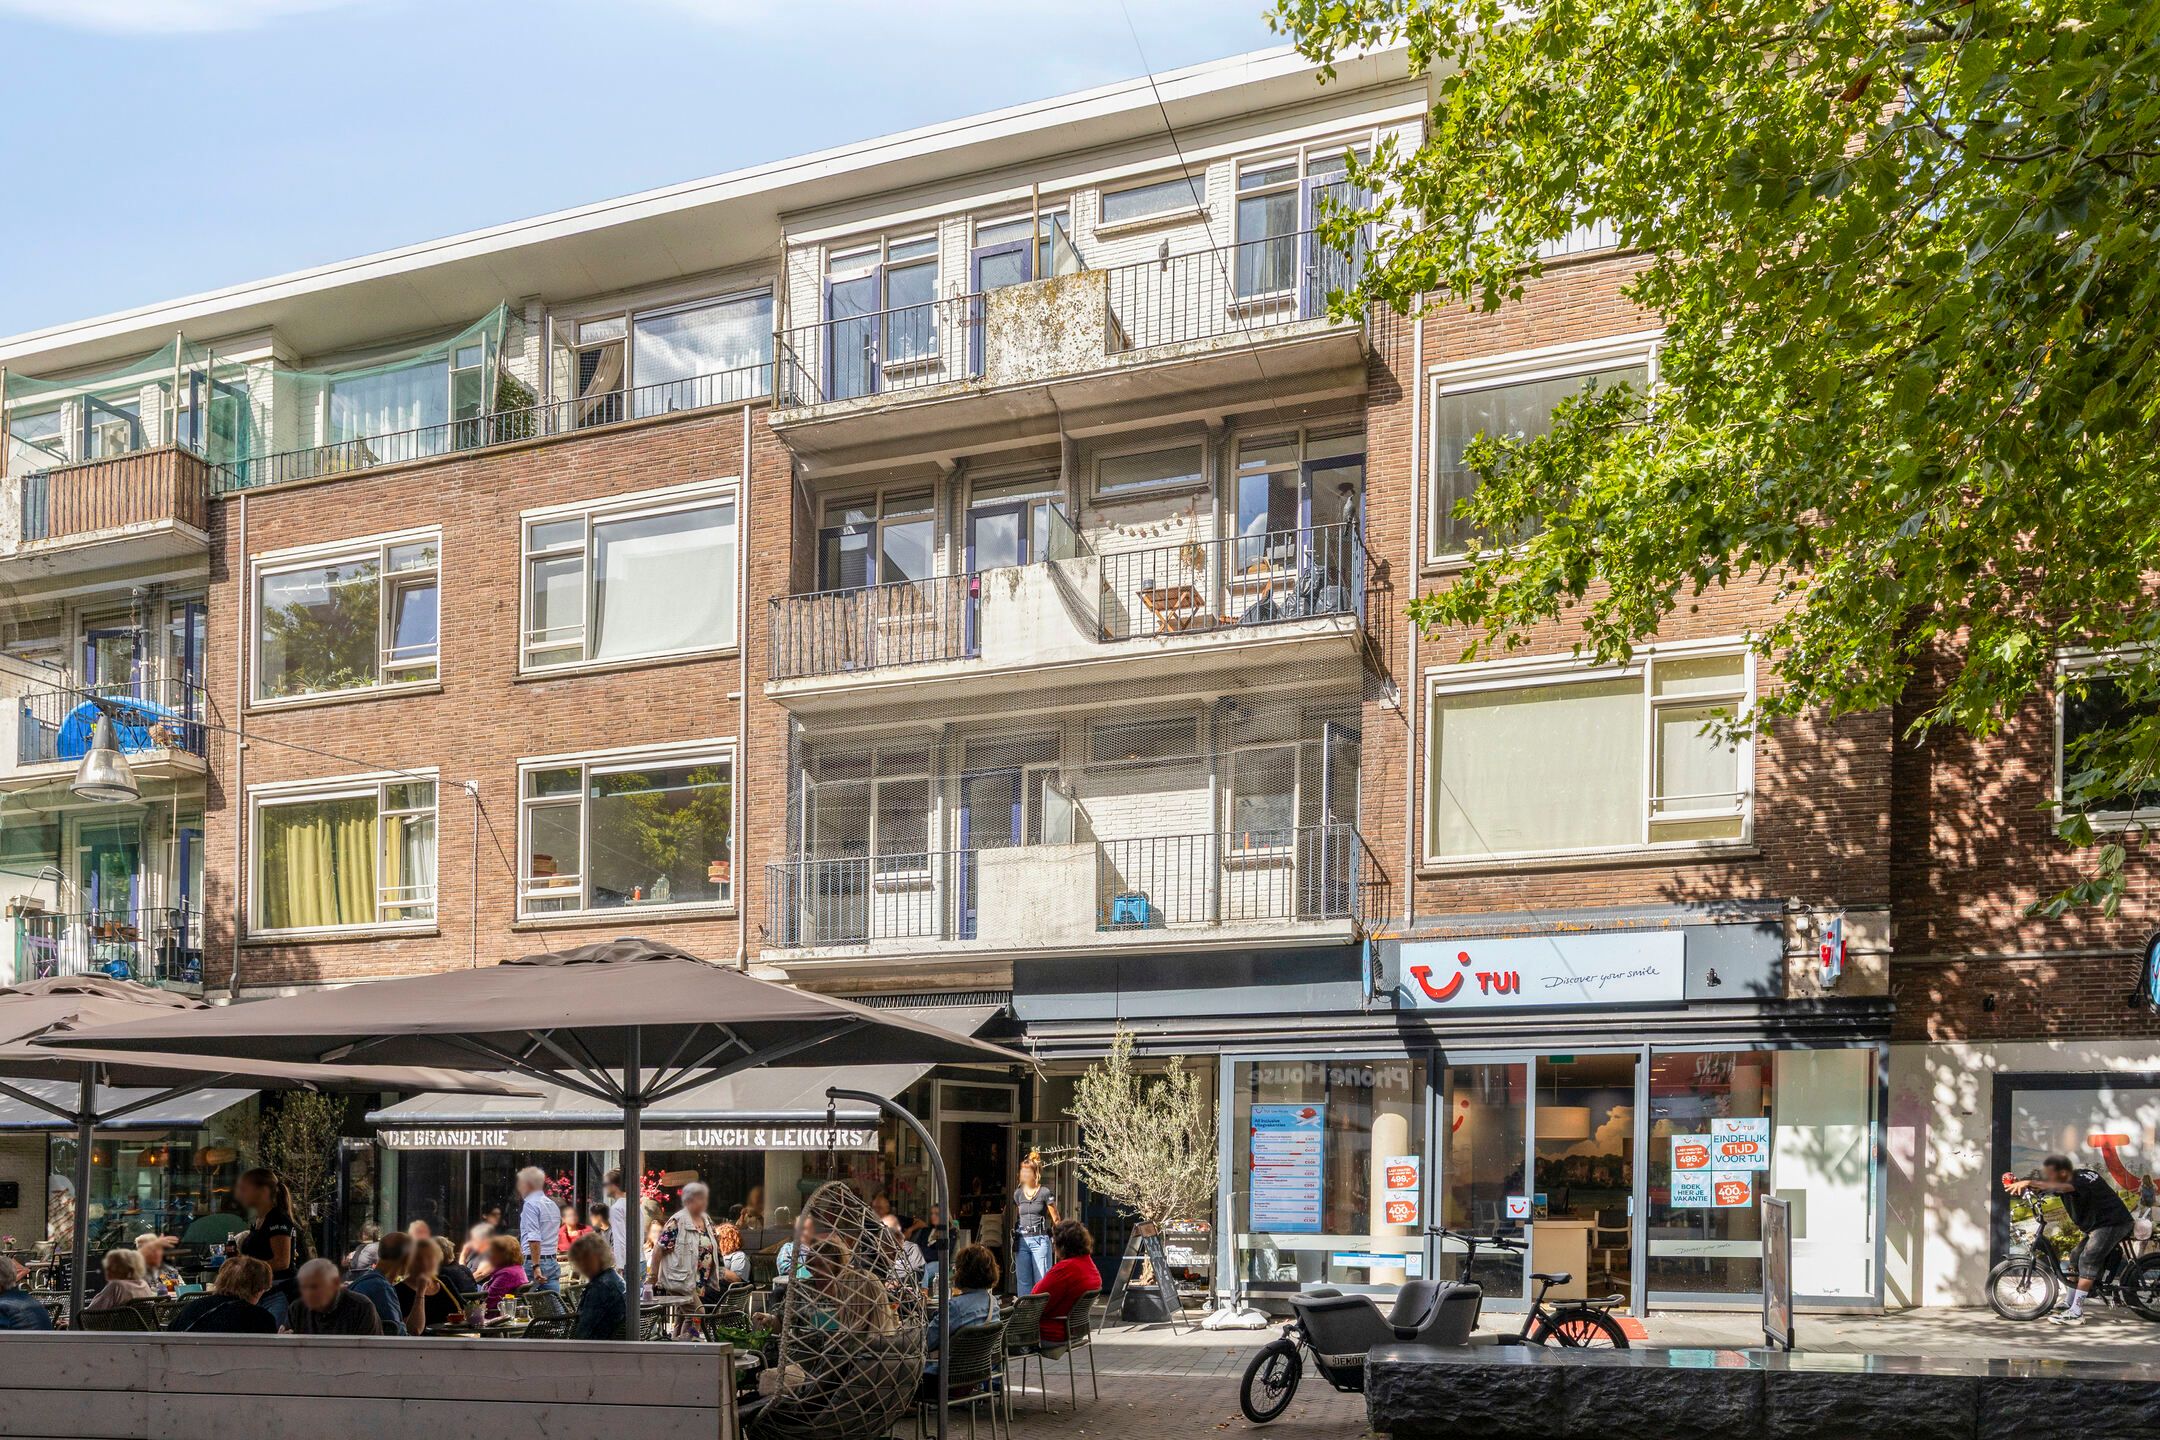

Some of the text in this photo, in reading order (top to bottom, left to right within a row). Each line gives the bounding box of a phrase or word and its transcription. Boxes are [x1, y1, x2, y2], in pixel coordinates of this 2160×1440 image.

[1475, 971, 1519, 992] TUI
[1540, 965, 1661, 989] Discover your smile
[389, 1129, 509, 1146] DE BRANDERIE
[685, 1129, 863, 1146] LUNCH & LEKKERS
[1713, 1134, 1767, 1143] EINDELIJK
[1726, 1143, 1754, 1154] TIJD
[1715, 1154, 1765, 1163] VOOR TUI
